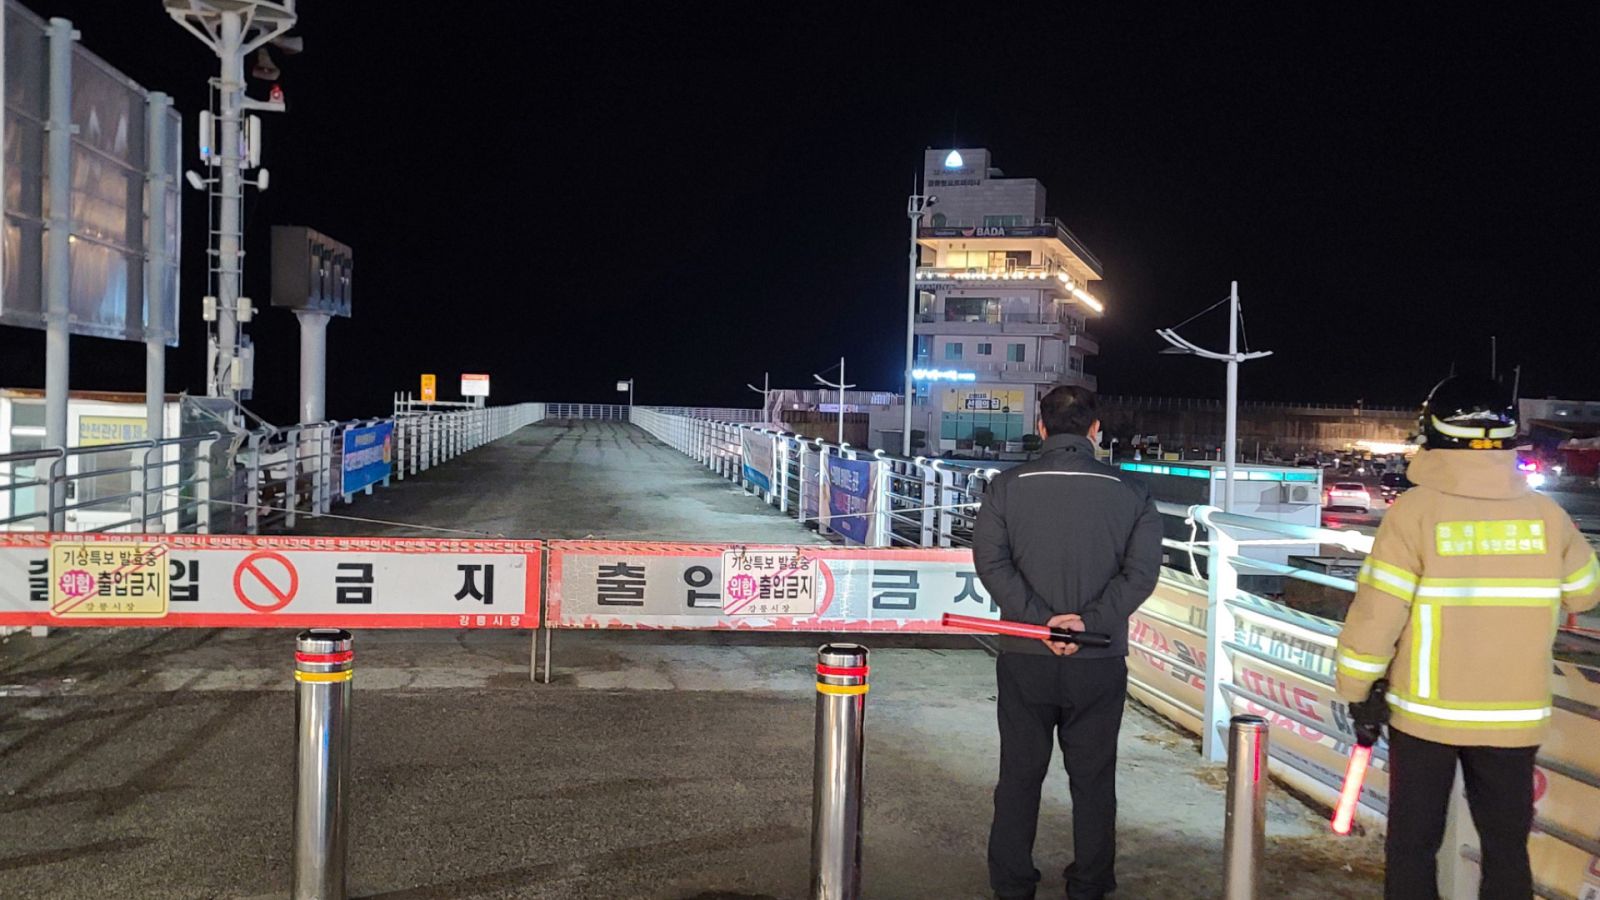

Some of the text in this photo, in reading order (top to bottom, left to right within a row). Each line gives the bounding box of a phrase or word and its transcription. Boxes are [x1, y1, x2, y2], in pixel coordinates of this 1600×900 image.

[976, 227, 1006, 237] BADA
[63, 551, 157, 567] 기상특보 발효중
[731, 555, 810, 571] 기상특보 발효중
[62, 573, 91, 595] 위험
[97, 571, 160, 597] 출입금지
[730, 574, 812, 600] 위험 출입금지
[459, 615, 521, 627] 강릉시장
